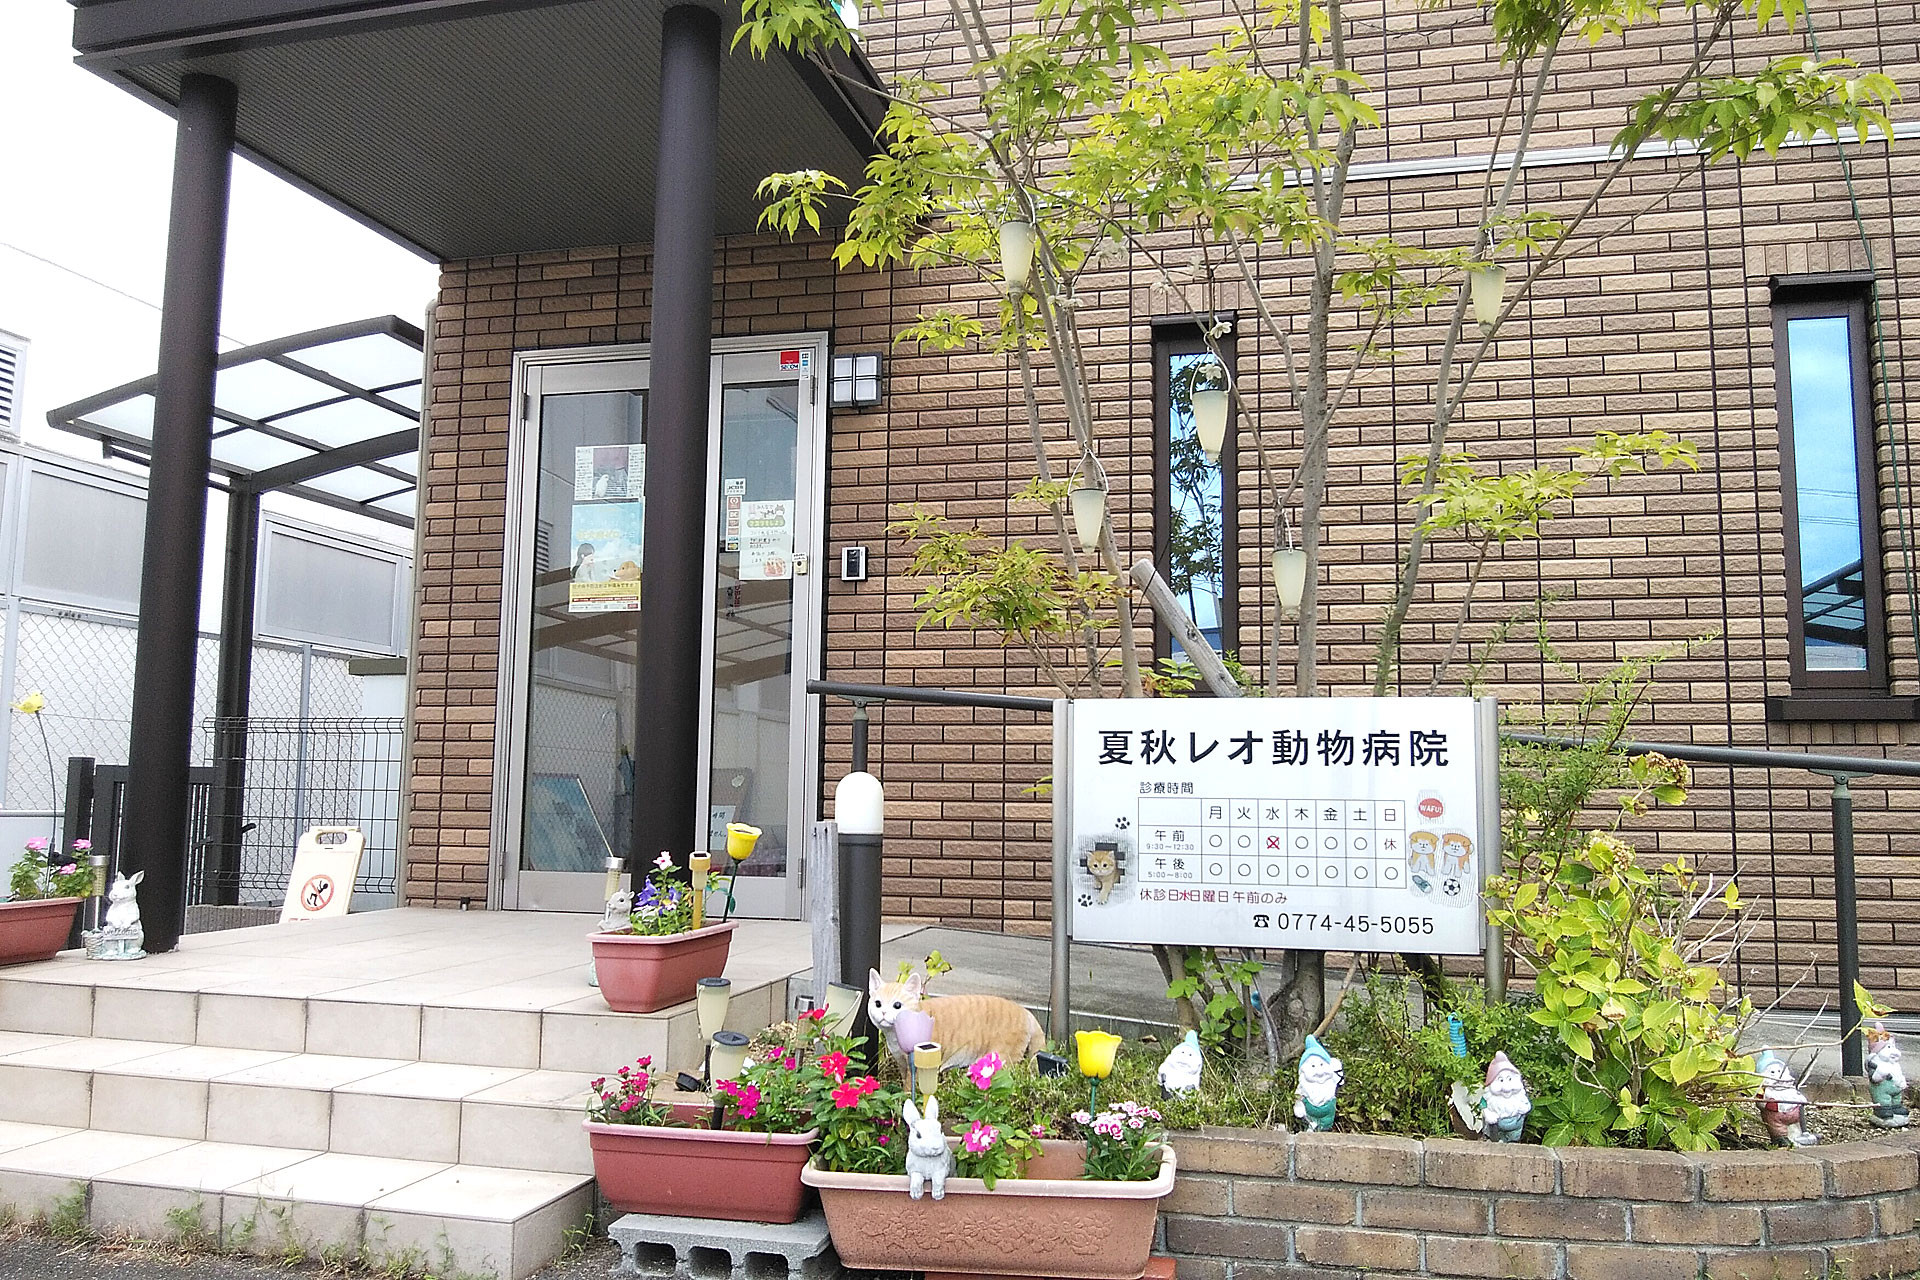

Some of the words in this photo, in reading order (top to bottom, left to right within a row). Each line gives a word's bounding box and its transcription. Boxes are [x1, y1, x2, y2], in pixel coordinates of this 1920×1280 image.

[1098, 729, 1449, 767] 夏秋レオ動物病院
[1139, 781, 1194, 795] 診療時間
[1208, 805, 1222, 820] 月
[1236, 806, 1251, 820] 火
[1265, 806, 1280, 821] 水
[1294, 807, 1309, 821] 木
[1323, 807, 1338, 821] 金
[1352, 807, 1368, 821] 土
[1384, 808, 1396, 822] 日
[1420, 804, 1443, 814] WAFU!
[1154, 829, 1185, 842] 午前
[1383, 837, 1397, 851] 休
[1154, 857, 1185, 870] 午後
[1278, 912, 1434, 935] 0774-45-5055
